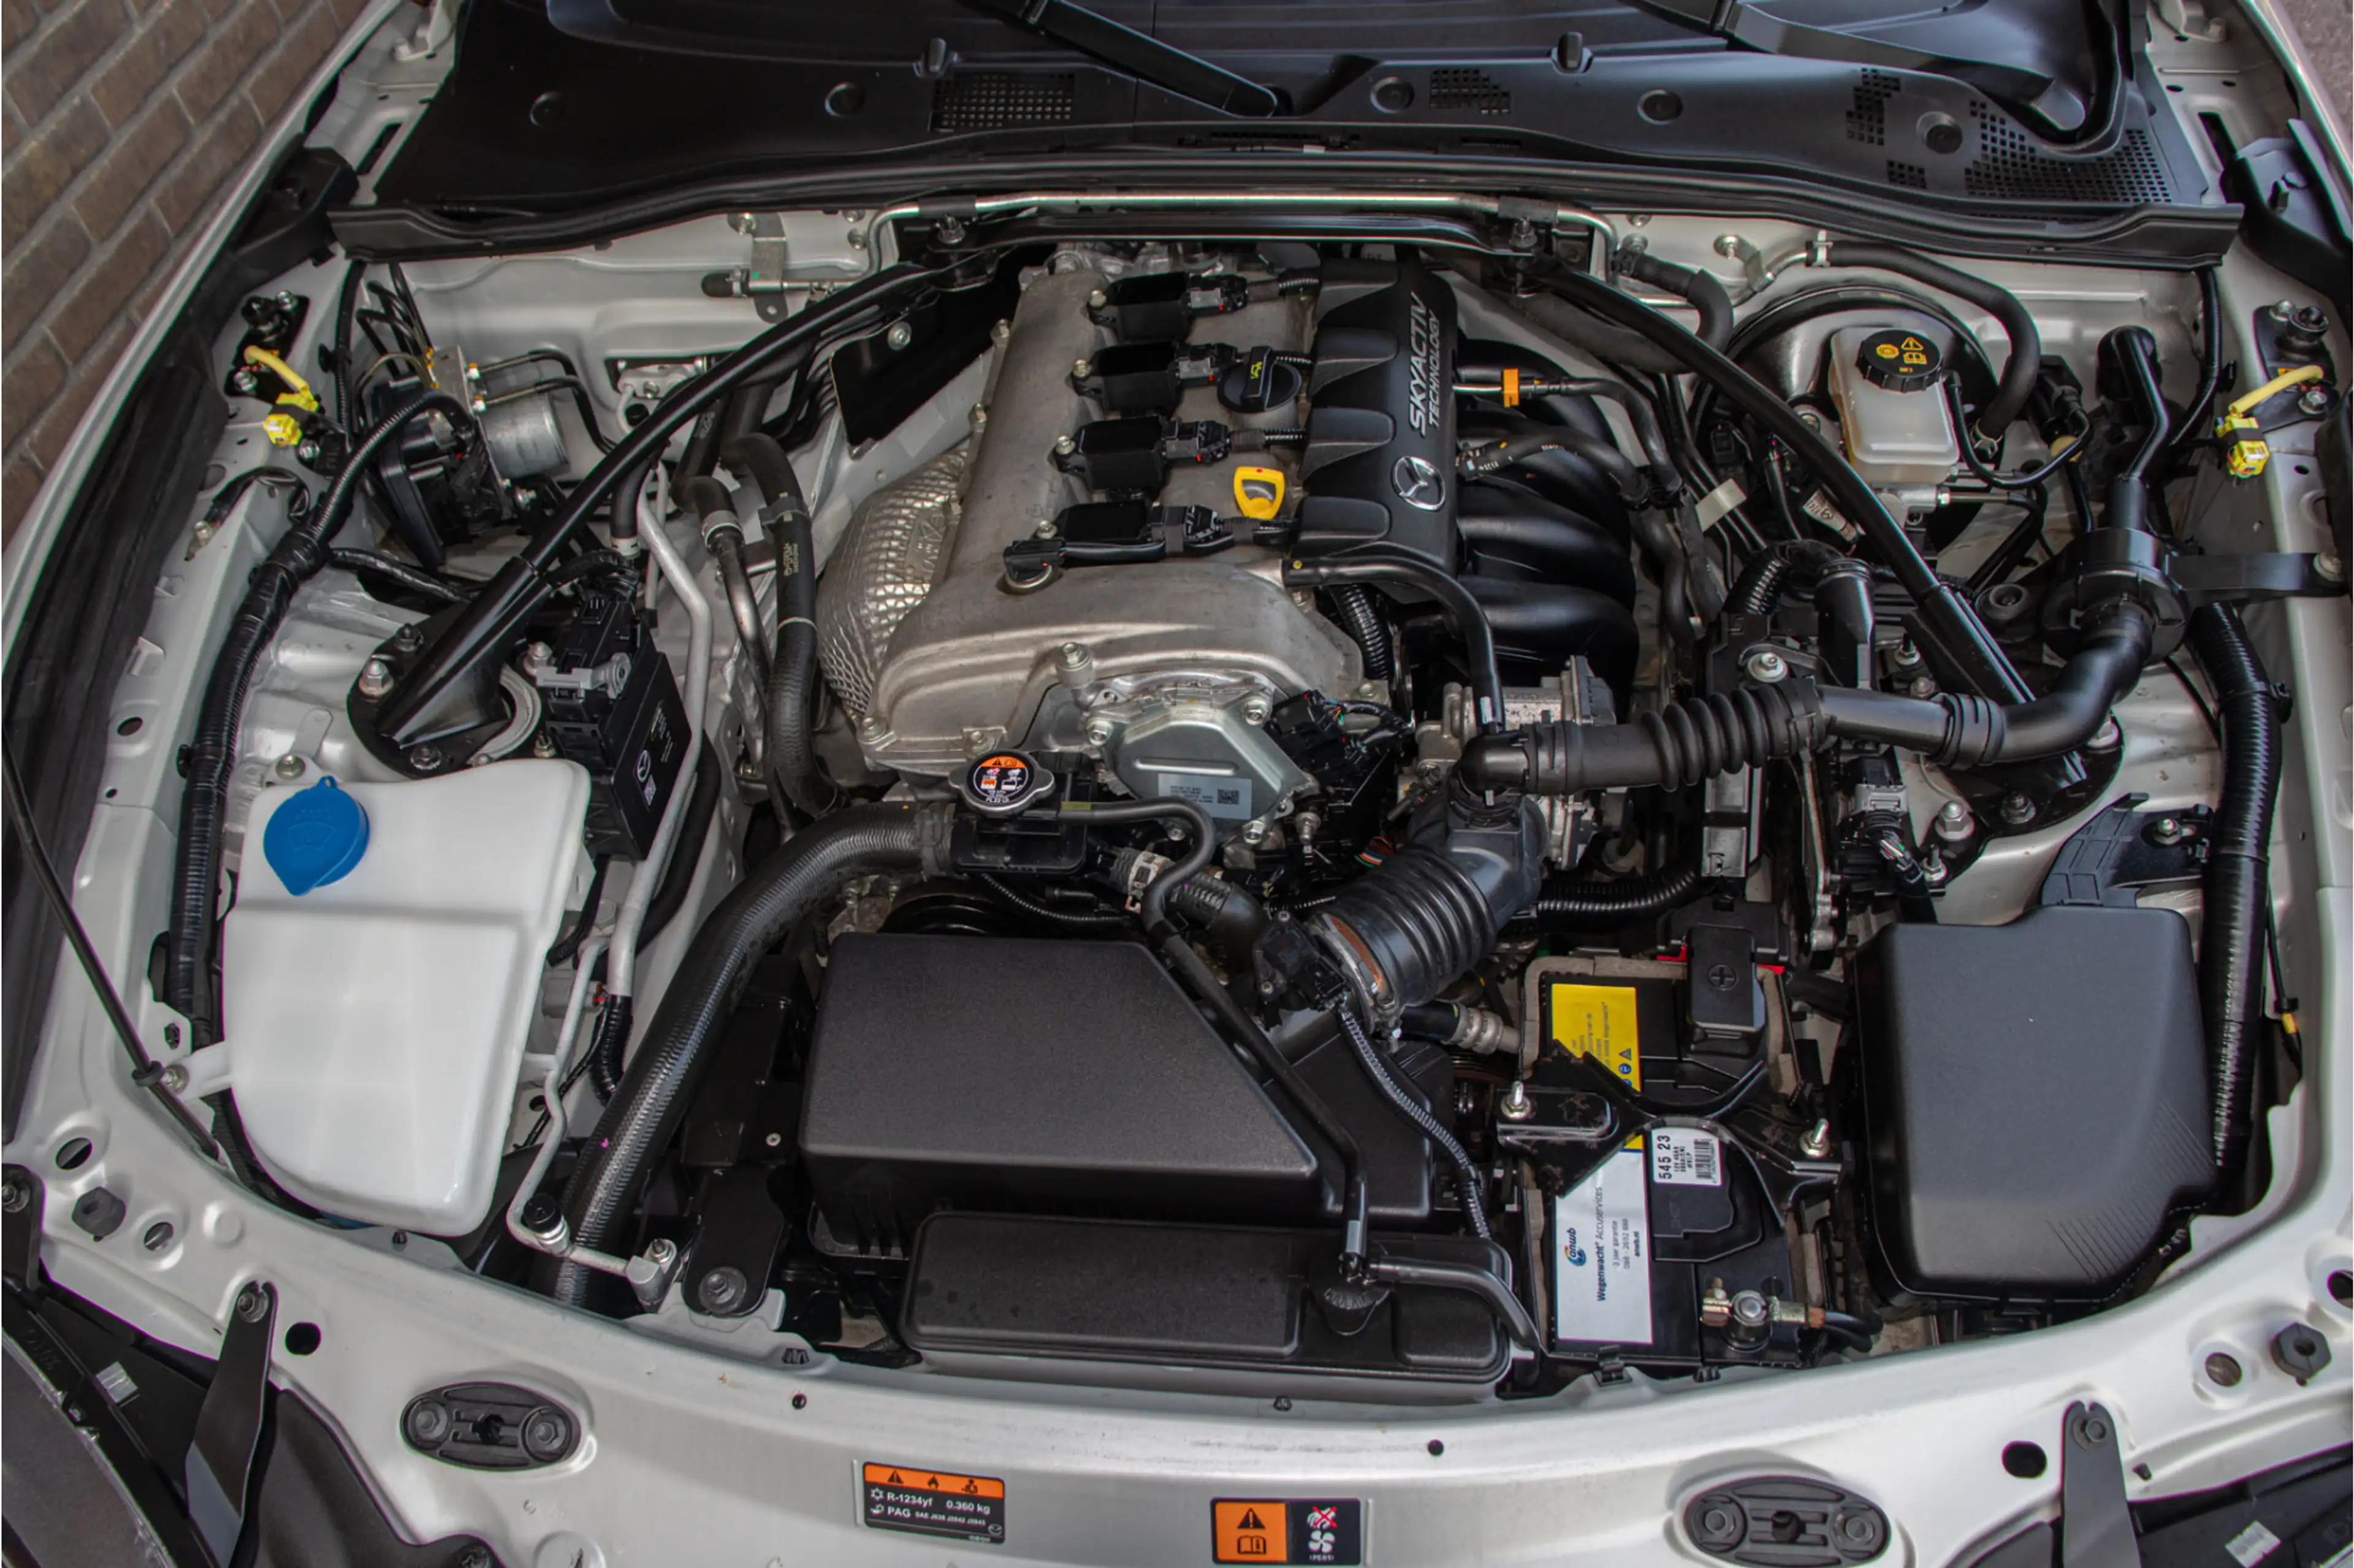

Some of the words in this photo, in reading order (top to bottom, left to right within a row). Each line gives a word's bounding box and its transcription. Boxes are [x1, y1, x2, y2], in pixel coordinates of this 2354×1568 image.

[1409, 291, 1427, 436] SKYACTIV
[1428, 309, 1440, 428] TECHNOLOGY
[1656, 1135, 1671, 1150] 23
[1658, 1156, 1672, 1179] 545
[1596, 1186, 1604, 1240] Accuservices
[1566, 1227, 1577, 1258] anwb
[1612, 1220, 1621, 1247] garantie
[1612, 1249, 1621, 1261] jaar
[886, 1491, 933, 1508] R-1234yf
[977, 1503, 991, 1515] kg
[887, 1506, 911, 1518] PAG
